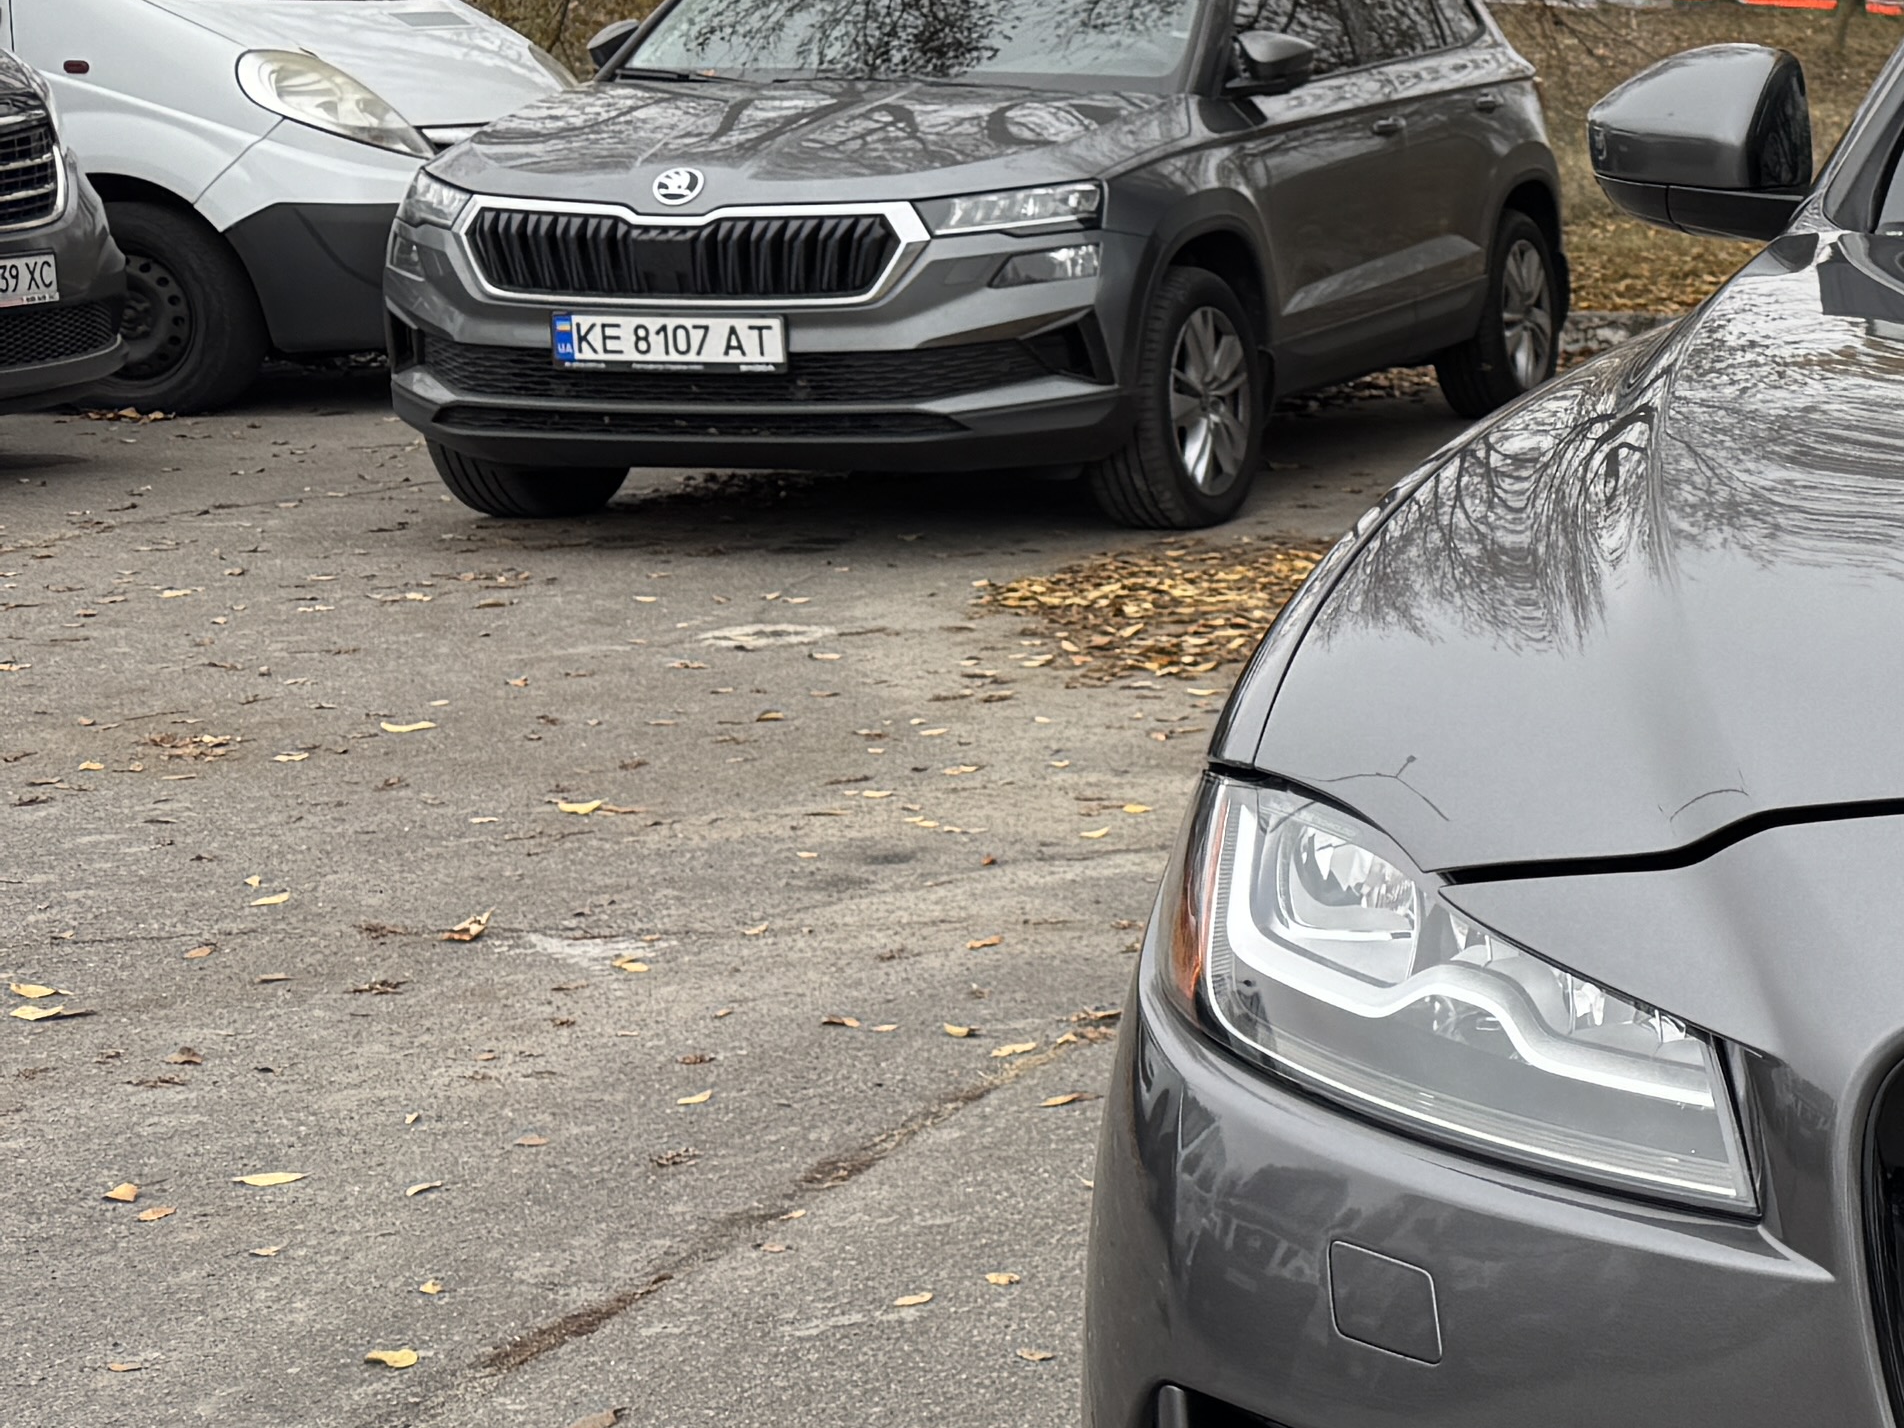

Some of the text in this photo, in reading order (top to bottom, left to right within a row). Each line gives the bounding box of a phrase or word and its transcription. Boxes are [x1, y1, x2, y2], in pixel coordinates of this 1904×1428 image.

[25, 260, 54, 291] XC
[557, 342, 573, 354] UA
[575, 322, 773, 357] KE 8107 AT
